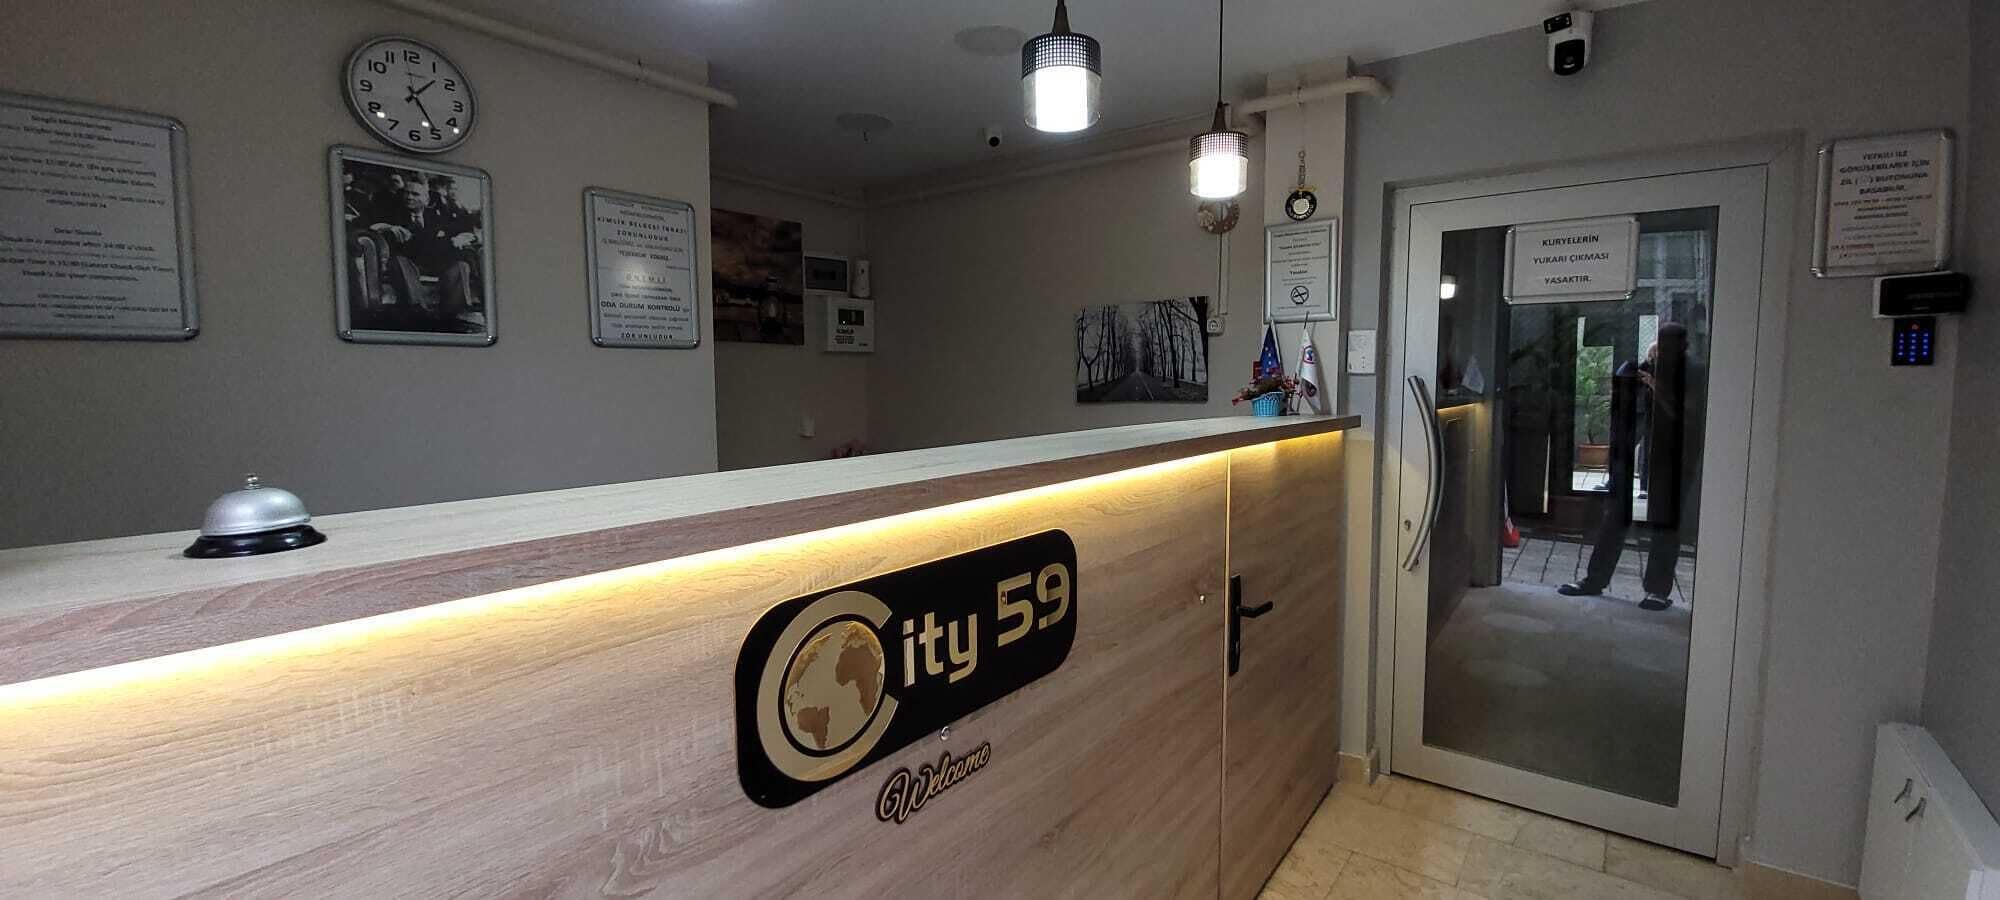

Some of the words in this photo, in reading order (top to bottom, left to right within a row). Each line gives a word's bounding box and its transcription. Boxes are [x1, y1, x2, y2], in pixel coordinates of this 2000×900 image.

[385, 51, 395, 64] 11
[403, 50, 421, 64] 12
[368, 59, 387, 74] 10
[432, 61, 436, 73] 1
[360, 79, 373, 92] 9
[443, 78, 456, 91] 2
[368, 101, 381, 114] 8
[453, 100, 464, 113] 3
[387, 118, 399, 130] 7
[446, 117, 458, 127] 4
[409, 130, 421, 141] 6
[430, 127, 442, 140] 5
[1542, 234, 1599, 247] KURYELERİN
[1533, 256, 1567, 264] YUKARI
[1569, 252, 1609, 264] ÇIKMASI
[600, 300, 617, 308] ODA
[619, 302, 645, 310] DURUM
[997, 562, 1071, 648] 59
[875, 741, 991, 824] Welcome
